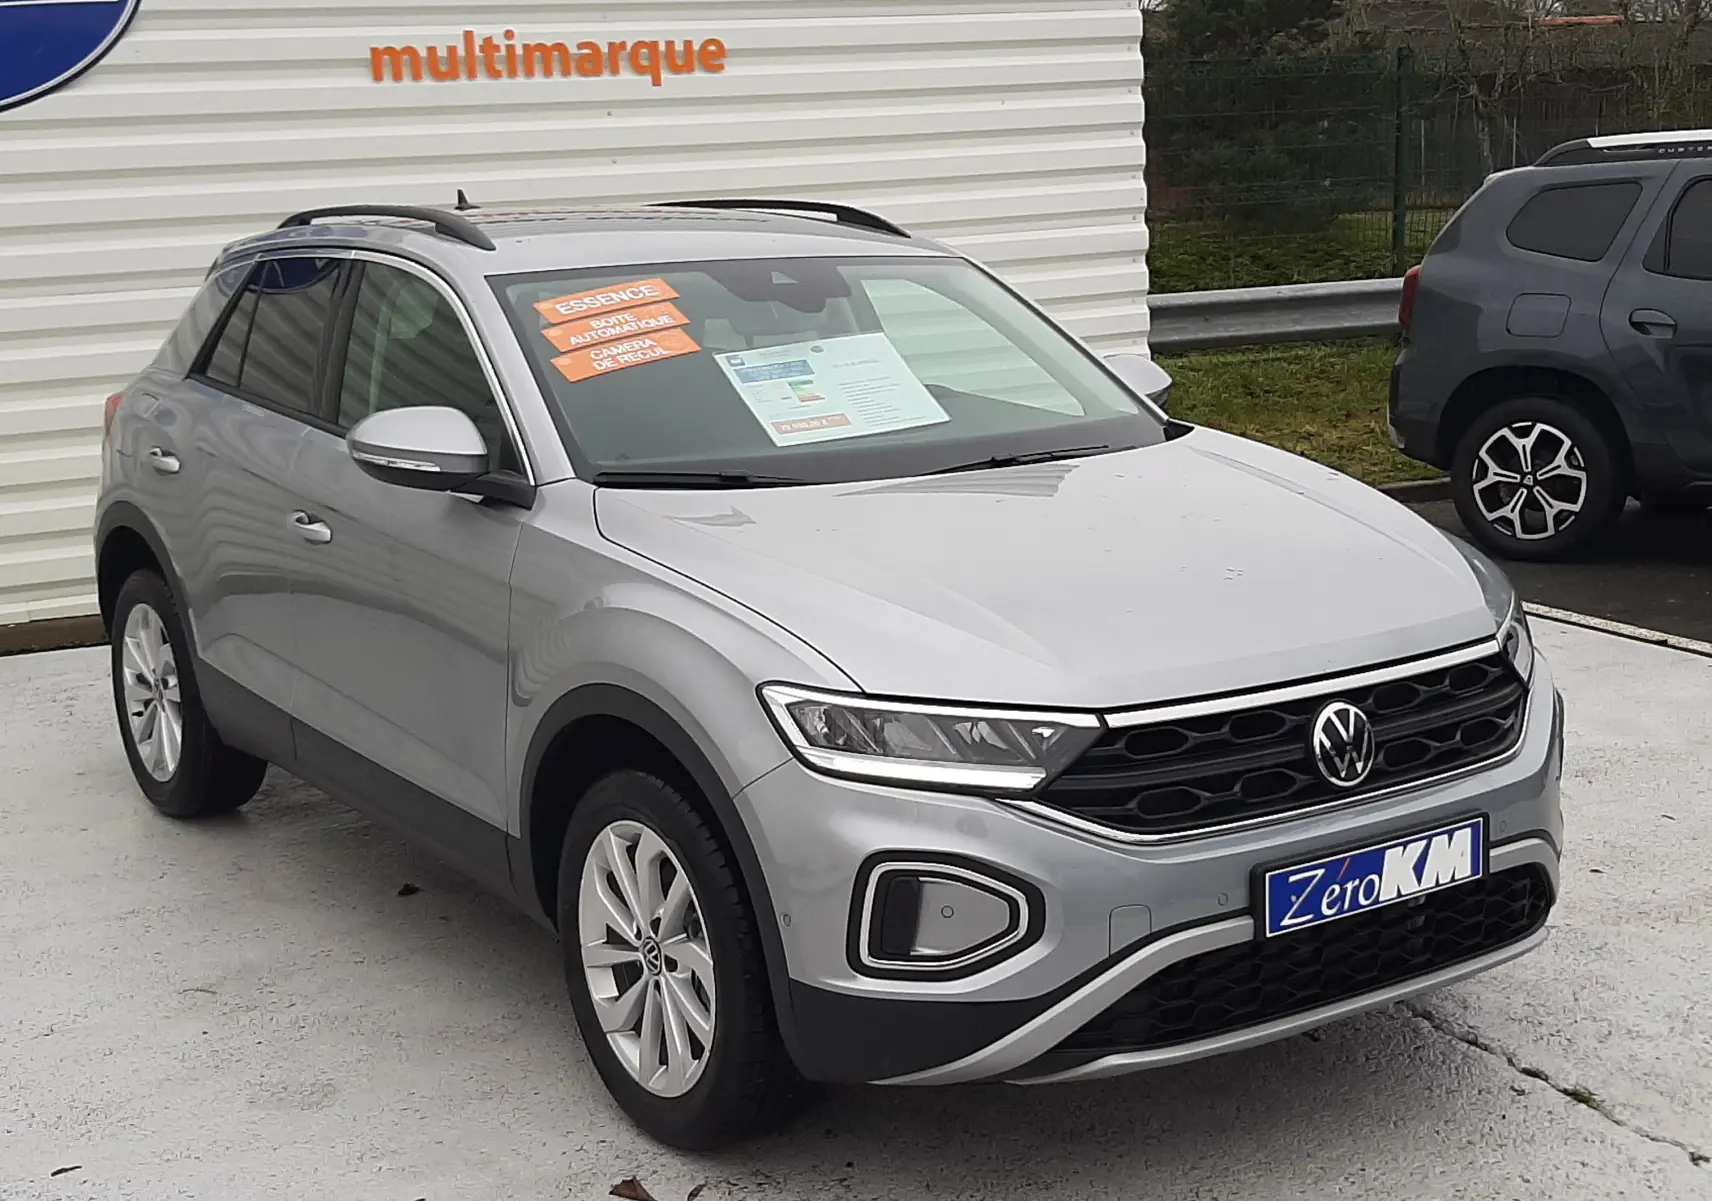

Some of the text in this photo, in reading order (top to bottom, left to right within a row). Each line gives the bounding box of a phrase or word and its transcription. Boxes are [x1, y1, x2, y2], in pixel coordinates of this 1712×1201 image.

[369, 29, 727, 87] multimarque
[555, 284, 661, 316] ESSENCE
[569, 315, 675, 346] AUTOMATIQUE
[589, 312, 637, 330] BOITE
[590, 338, 657, 361] CAMERA
[593, 348, 671, 371] DE RECUL
